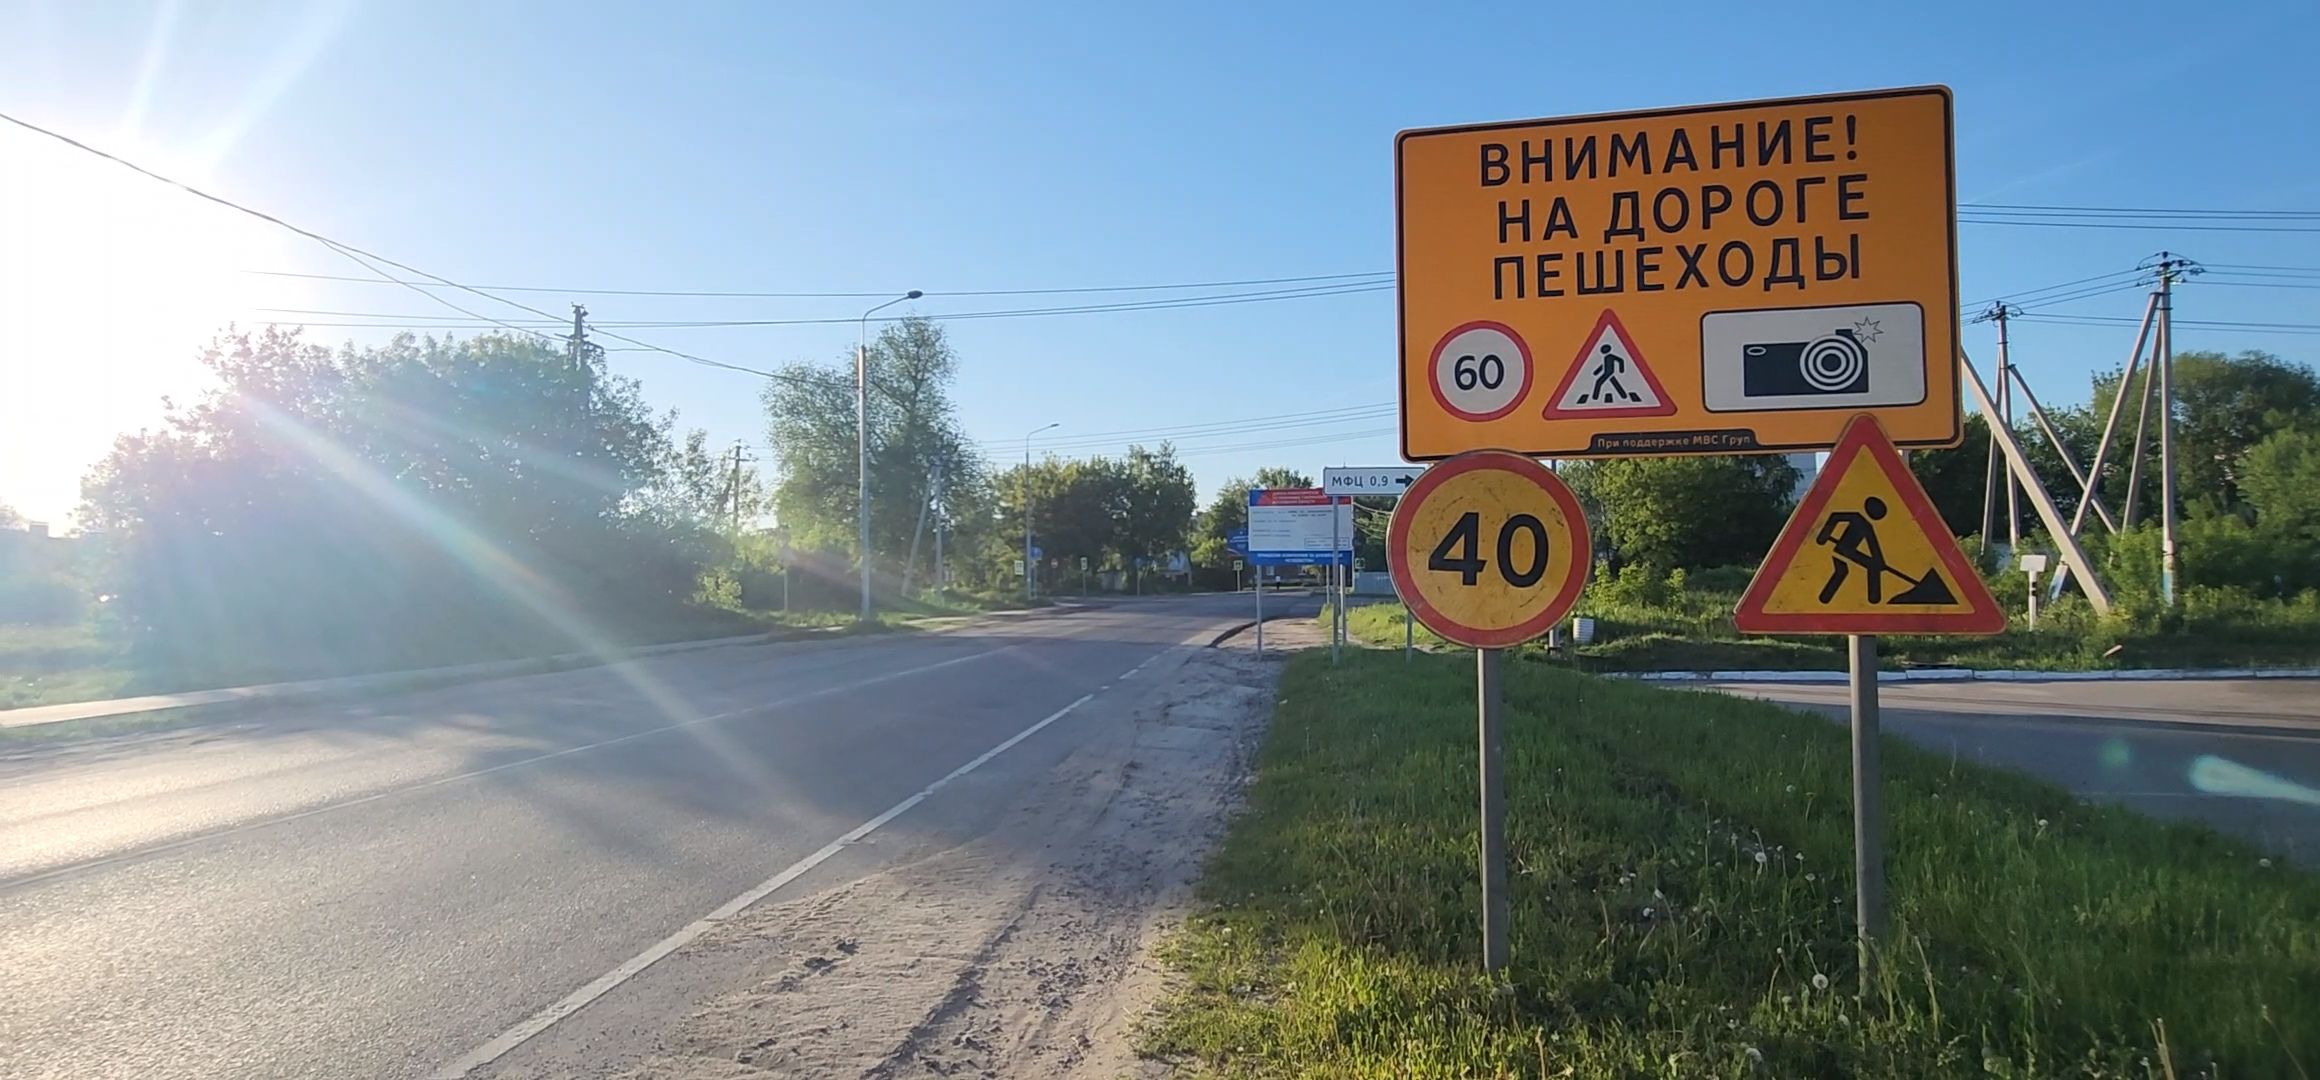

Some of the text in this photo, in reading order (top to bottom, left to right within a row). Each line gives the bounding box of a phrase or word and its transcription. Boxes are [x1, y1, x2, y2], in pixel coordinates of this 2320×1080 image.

[1480, 114, 1857, 187] ВНИМАНИЕ!
[1498, 174, 1870, 244] НА ДОРОГЕ
[1493, 233, 1860, 299] ПЕШЕХОДЫ
[1454, 354, 1504, 390] 60
[1597, 434, 1751, 449] При поддержке МВС Груп
[1331, 475, 1363, 488] МФЦ
[1428, 512, 1549, 588] 40
